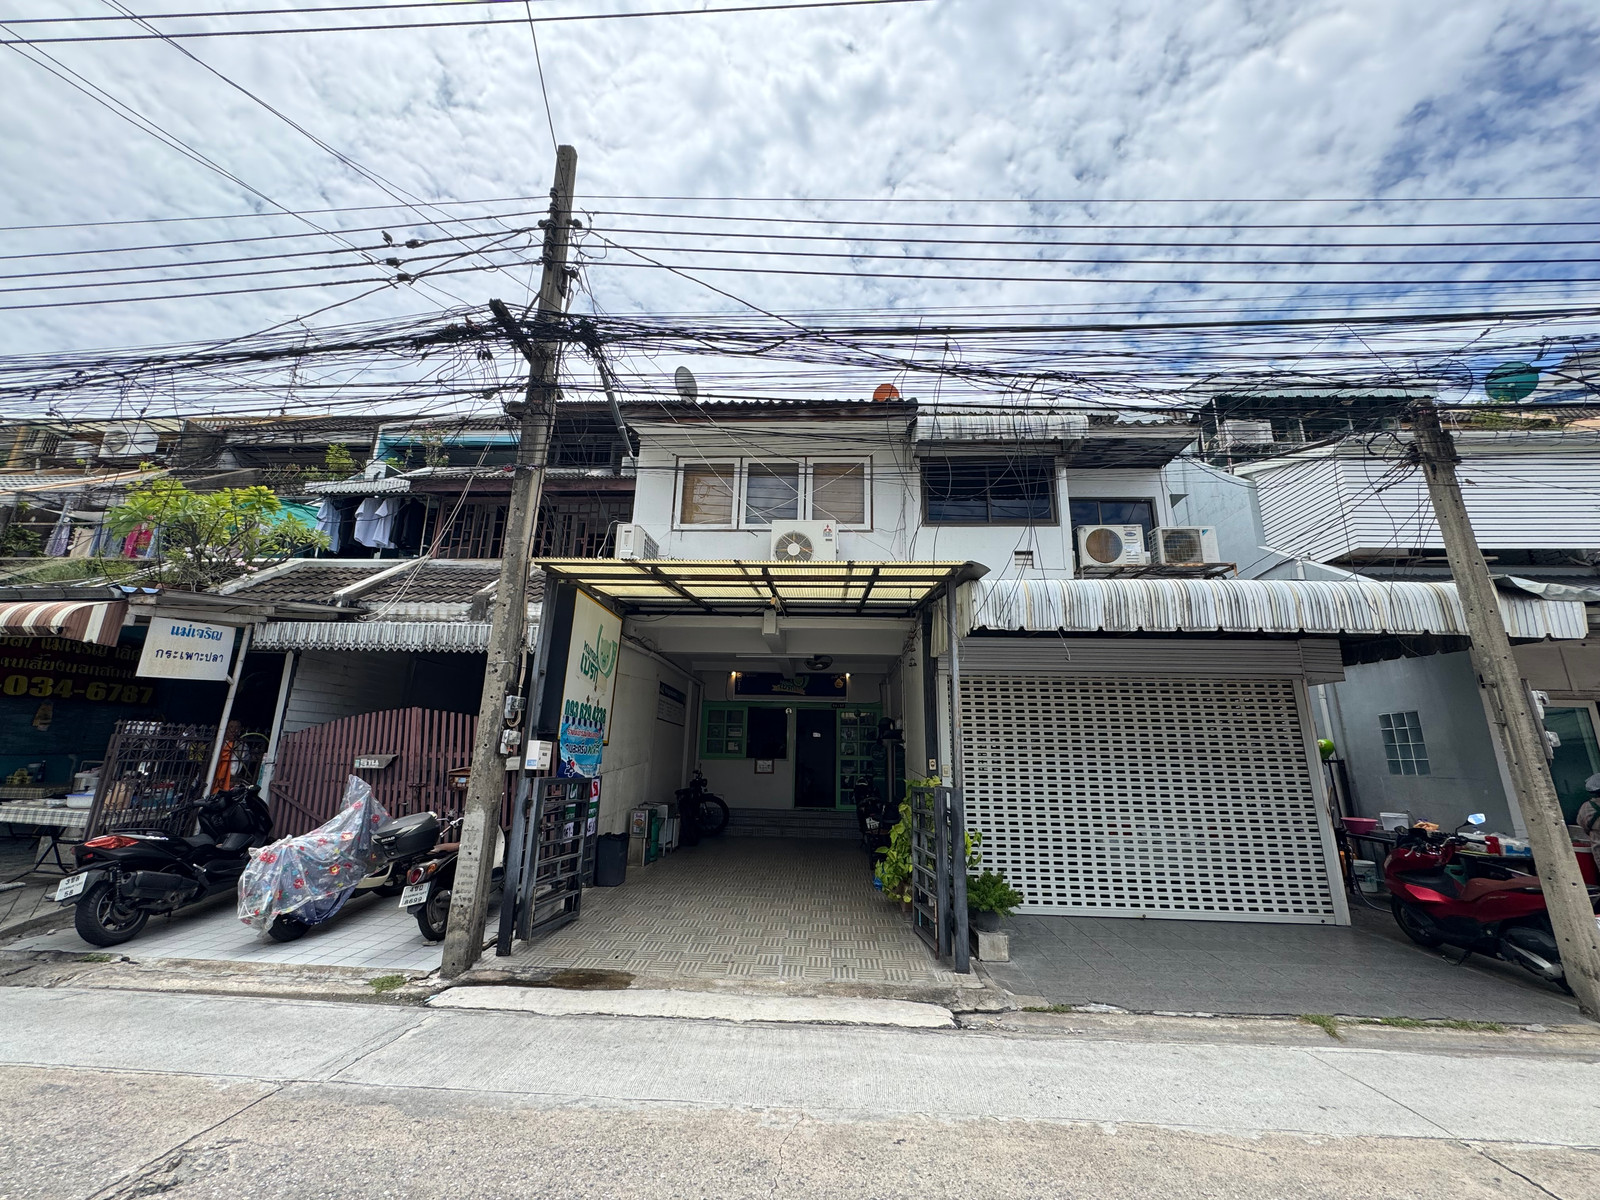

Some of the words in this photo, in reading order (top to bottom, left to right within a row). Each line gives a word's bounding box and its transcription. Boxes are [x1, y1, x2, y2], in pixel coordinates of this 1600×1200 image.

[170, 624, 223, 641] แม่เจริญ
[155, 649, 224, 663] กระเพาะปลา
